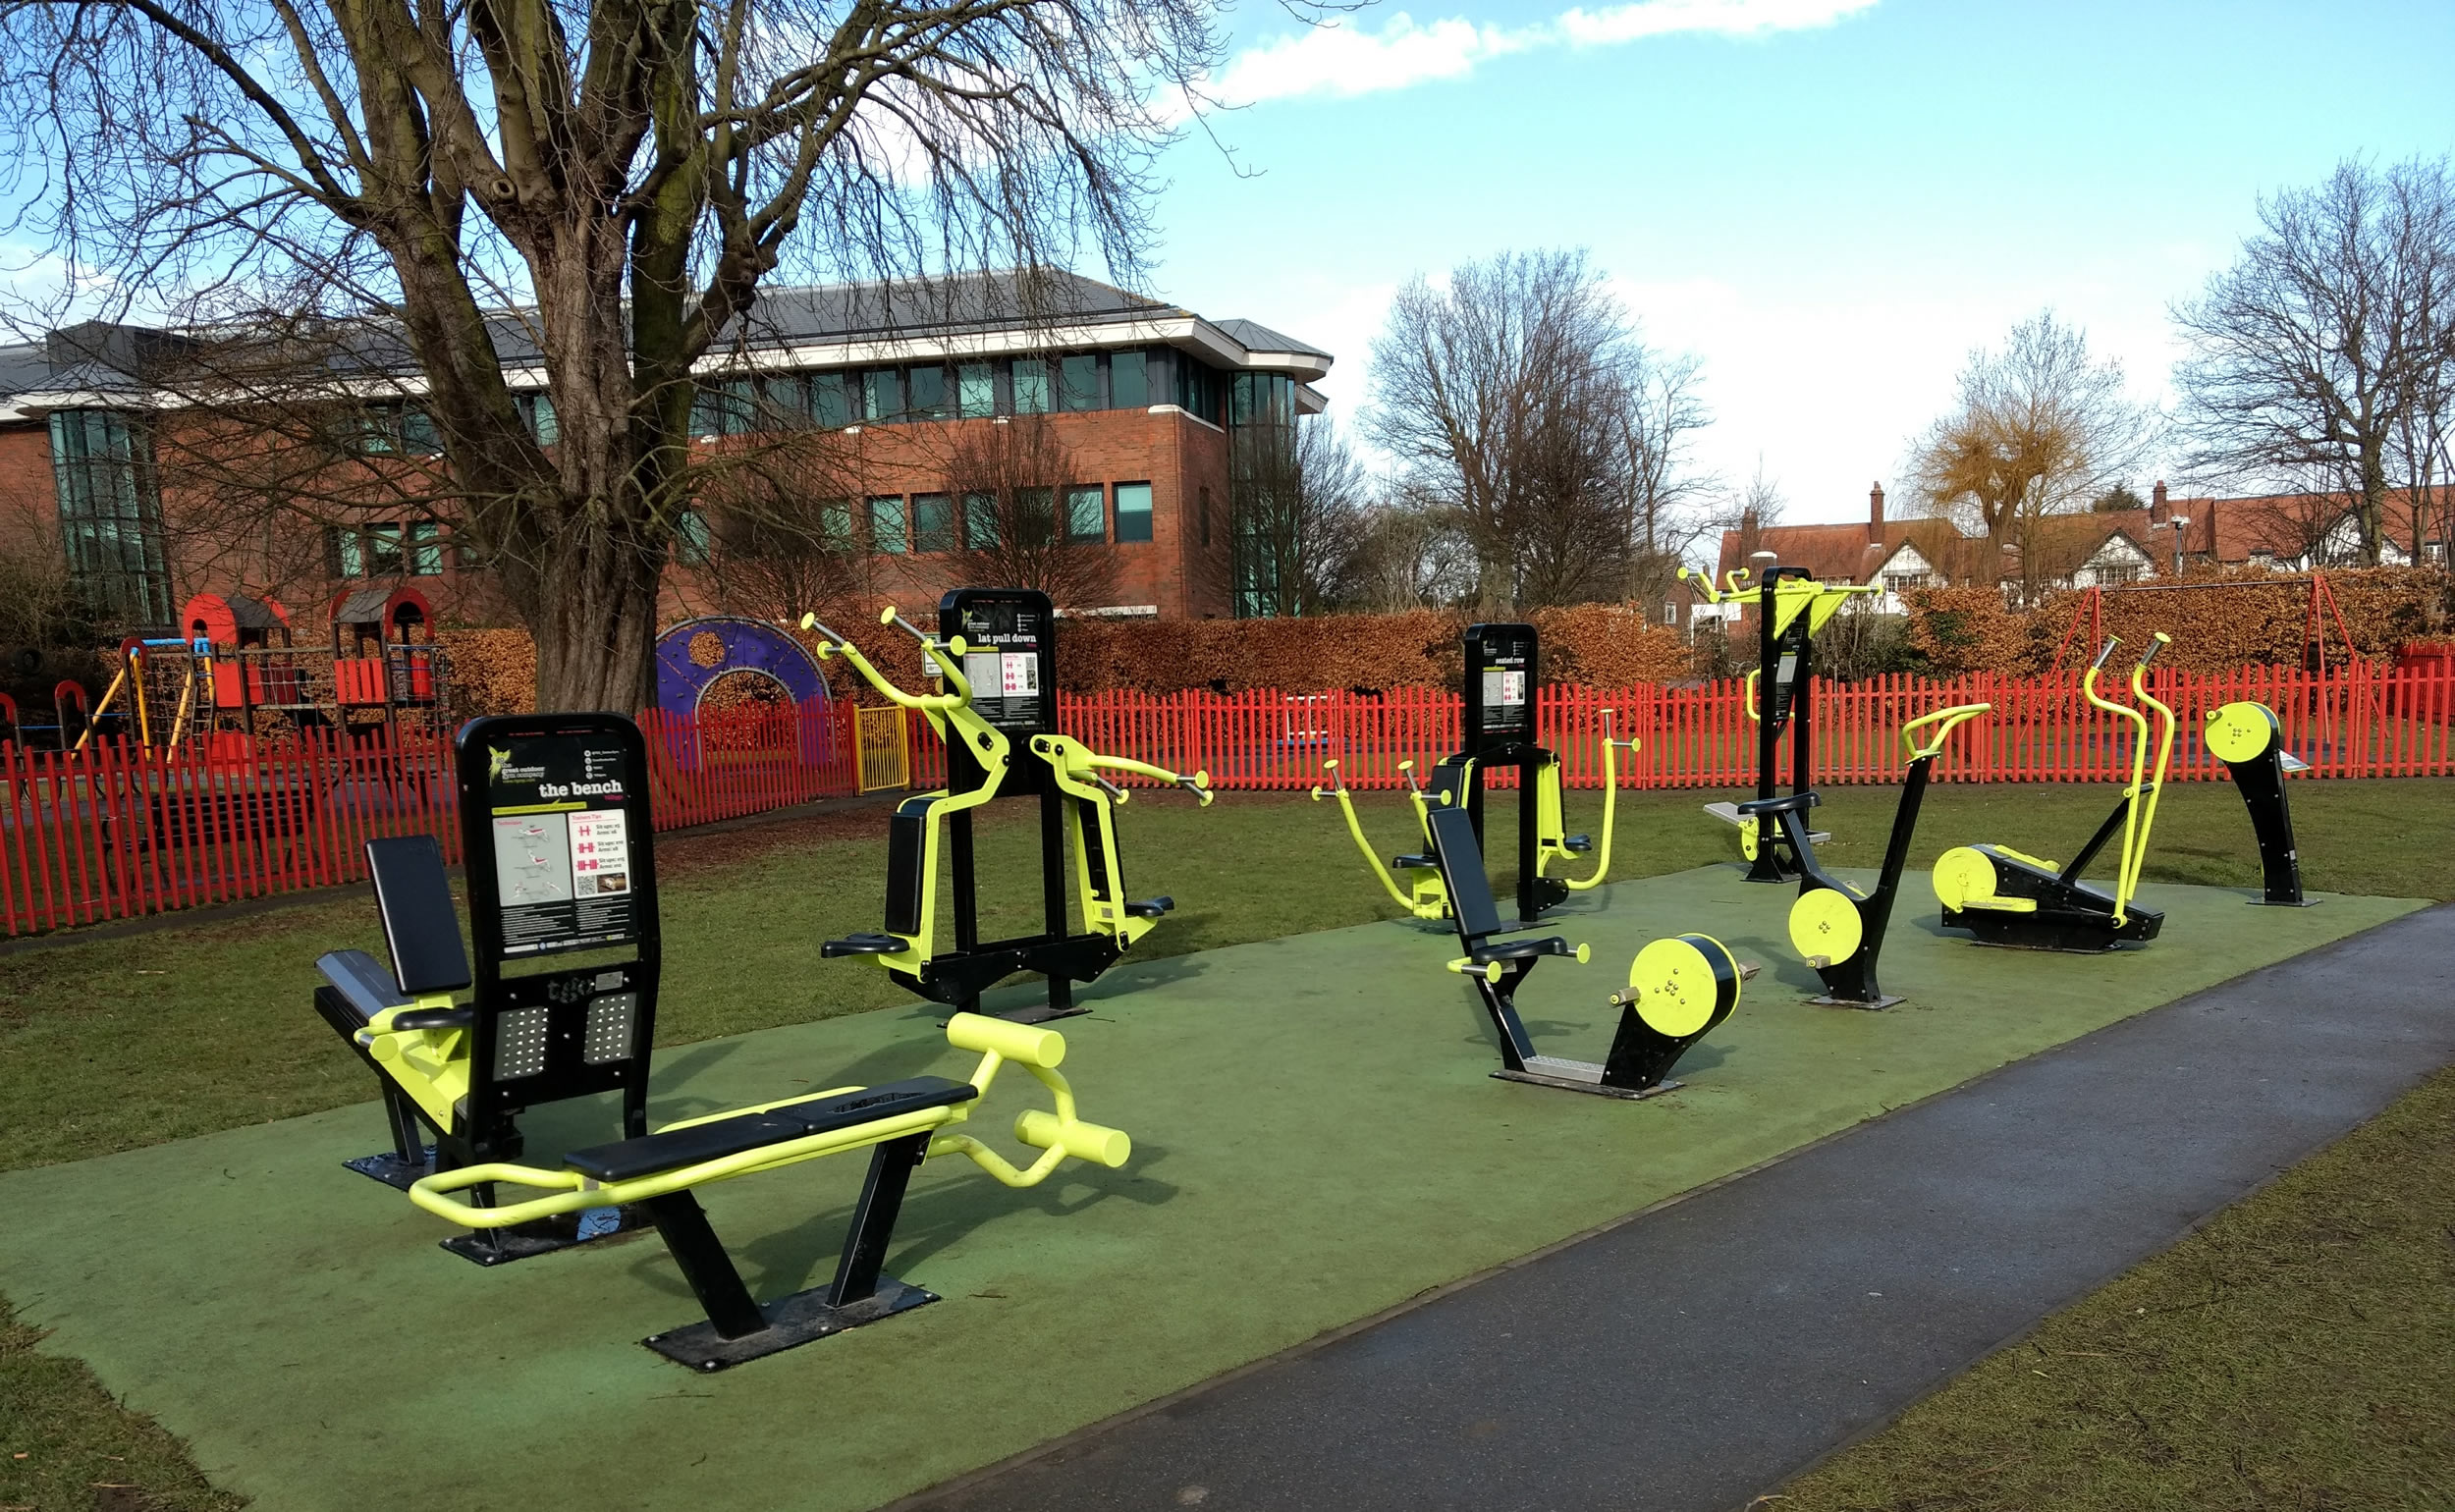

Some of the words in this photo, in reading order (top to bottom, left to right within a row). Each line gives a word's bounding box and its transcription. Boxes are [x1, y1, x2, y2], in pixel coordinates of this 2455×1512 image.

[978, 633, 991, 643] lat
[993, 632, 1010, 644] pull
[1011, 632, 1036, 643] down
[538, 783, 569, 797] the
[571, 780, 623, 795] bench
